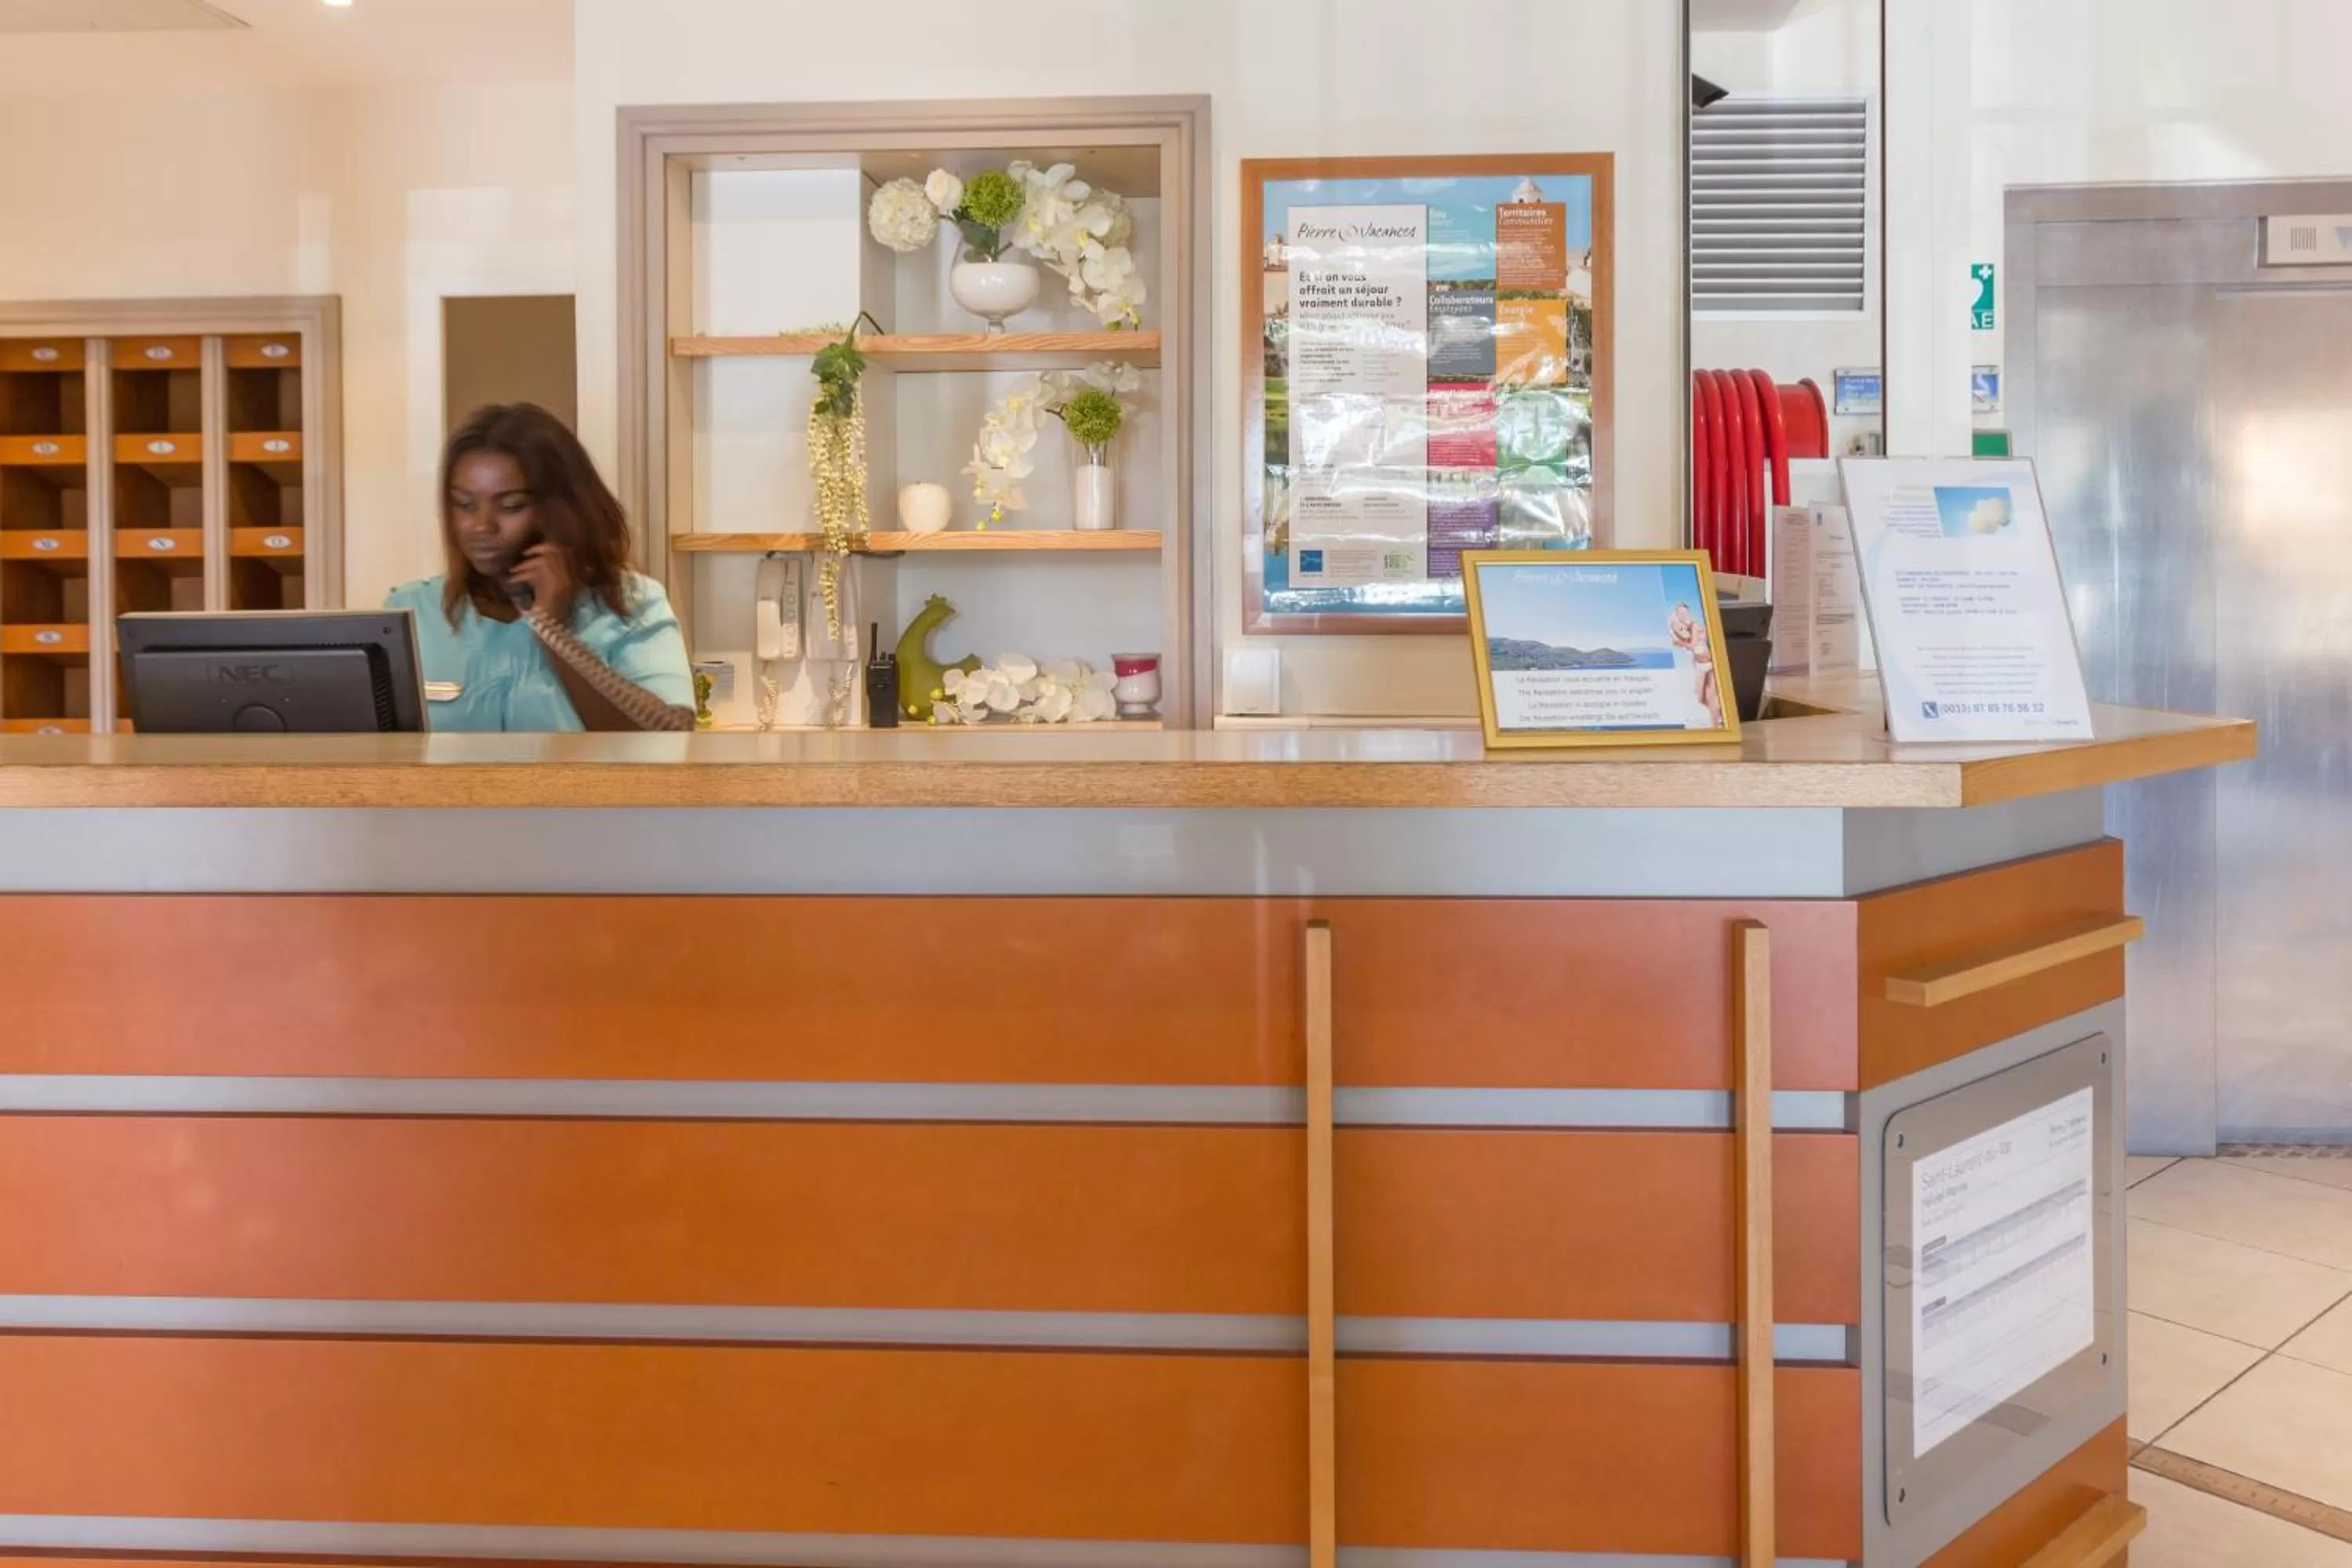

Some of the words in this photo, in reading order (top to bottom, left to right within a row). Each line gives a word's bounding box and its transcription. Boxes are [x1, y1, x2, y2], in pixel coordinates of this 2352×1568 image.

[1498, 207, 1547, 218] Territoires
[1298, 222, 1336, 238] Pierre
[1359, 222, 1417, 238] Vacances
[1299, 285, 1335, 295] offrait
[1355, 285, 1388, 296] séjour
[1299, 298, 1348, 308] vraiment
[1352, 297, 1393, 307] durable
[218, 664, 285, 682] NEC
